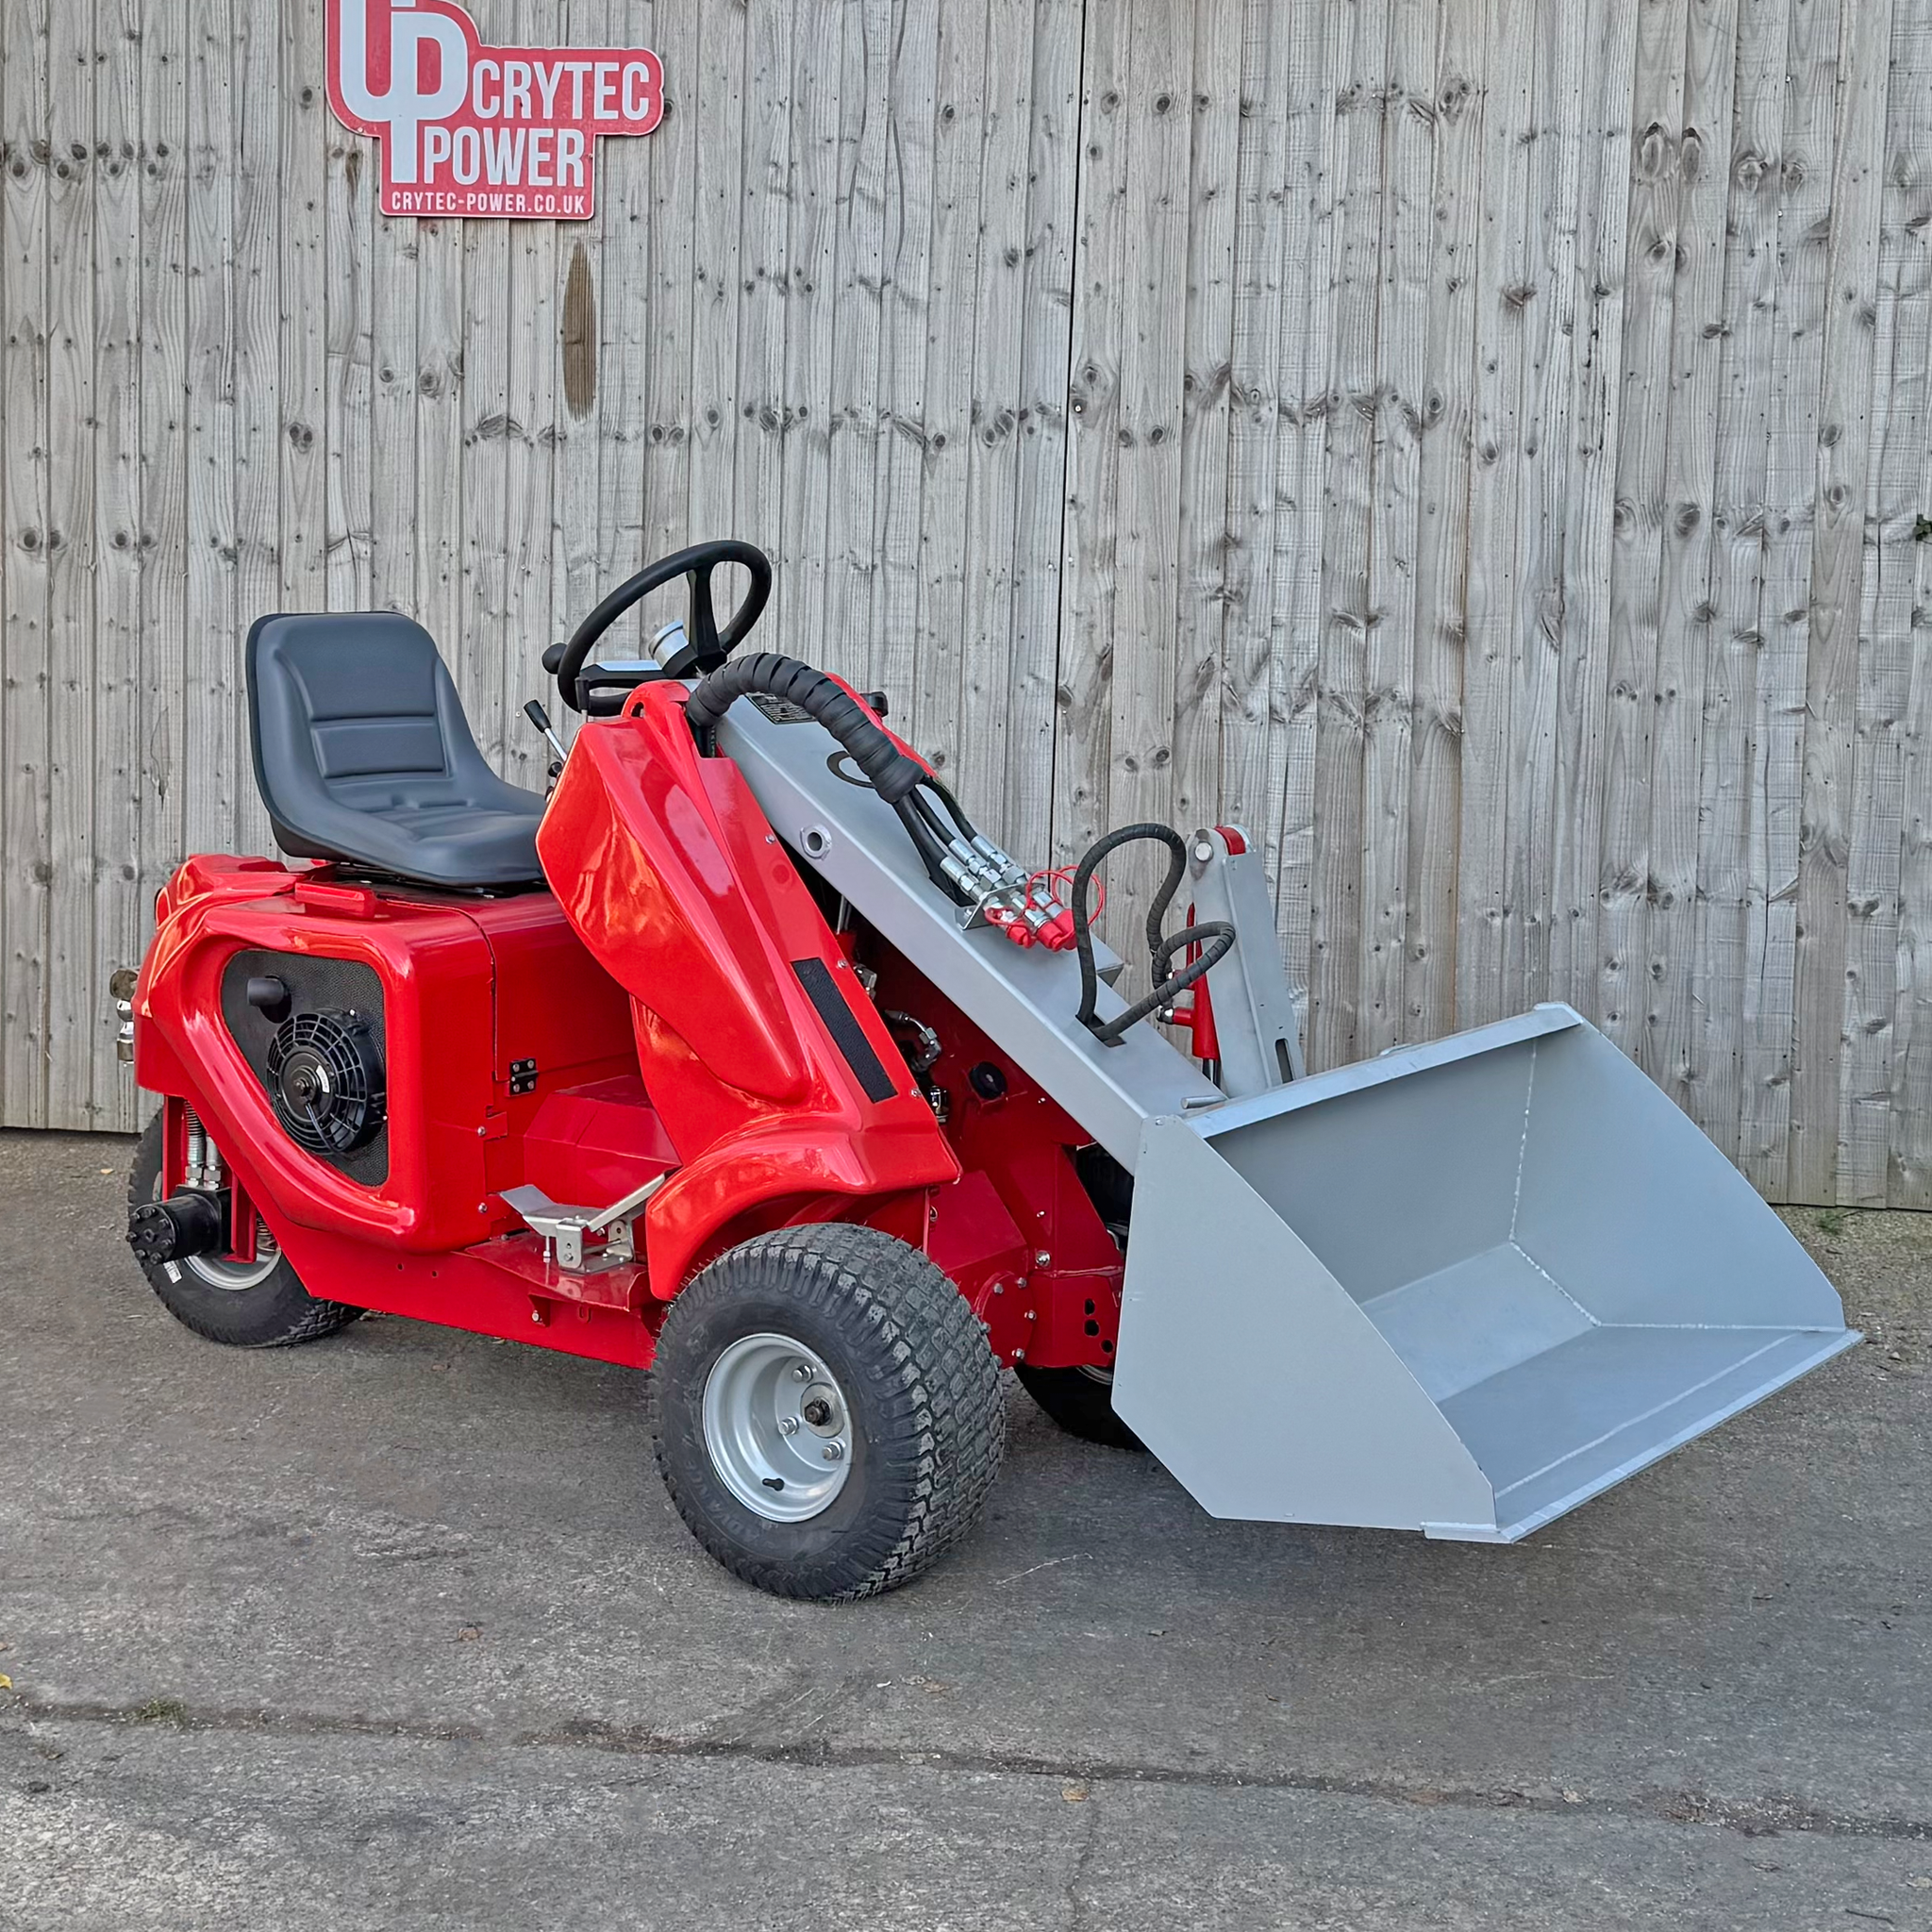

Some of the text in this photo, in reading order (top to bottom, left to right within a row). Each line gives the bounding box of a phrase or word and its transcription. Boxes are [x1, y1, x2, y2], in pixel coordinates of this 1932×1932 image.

[473, 59, 649, 120] CRYTEC
[424, 126, 584, 187] POWER
[391, 192, 585, 214] CRYTEC-POWER.CO.UK
